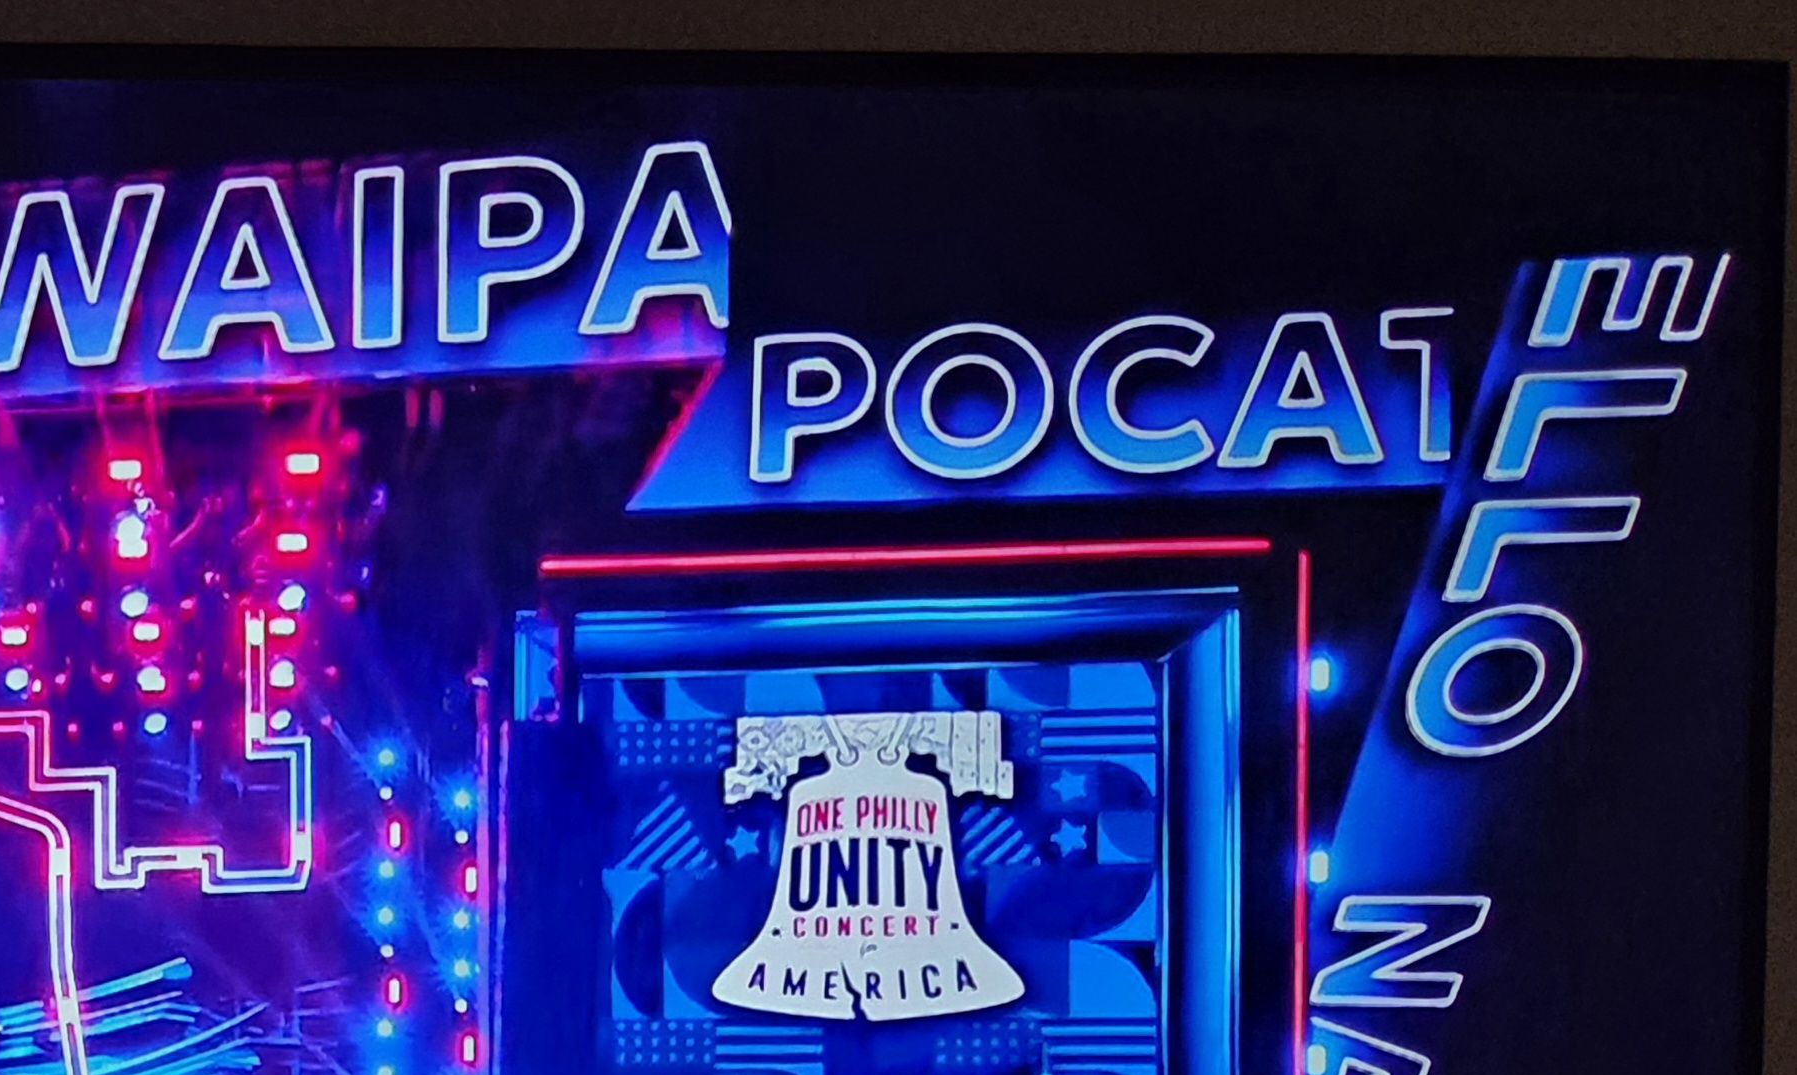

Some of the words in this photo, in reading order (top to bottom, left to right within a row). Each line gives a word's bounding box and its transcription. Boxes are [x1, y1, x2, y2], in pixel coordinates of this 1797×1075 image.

[797, 798, 845, 838] ONE
[856, 795, 937, 836] PHILLY
[788, 837, 944, 913] UNITY
[793, 915, 941, 938] CONCERT
[748, 958, 978, 1000] AMERICA
